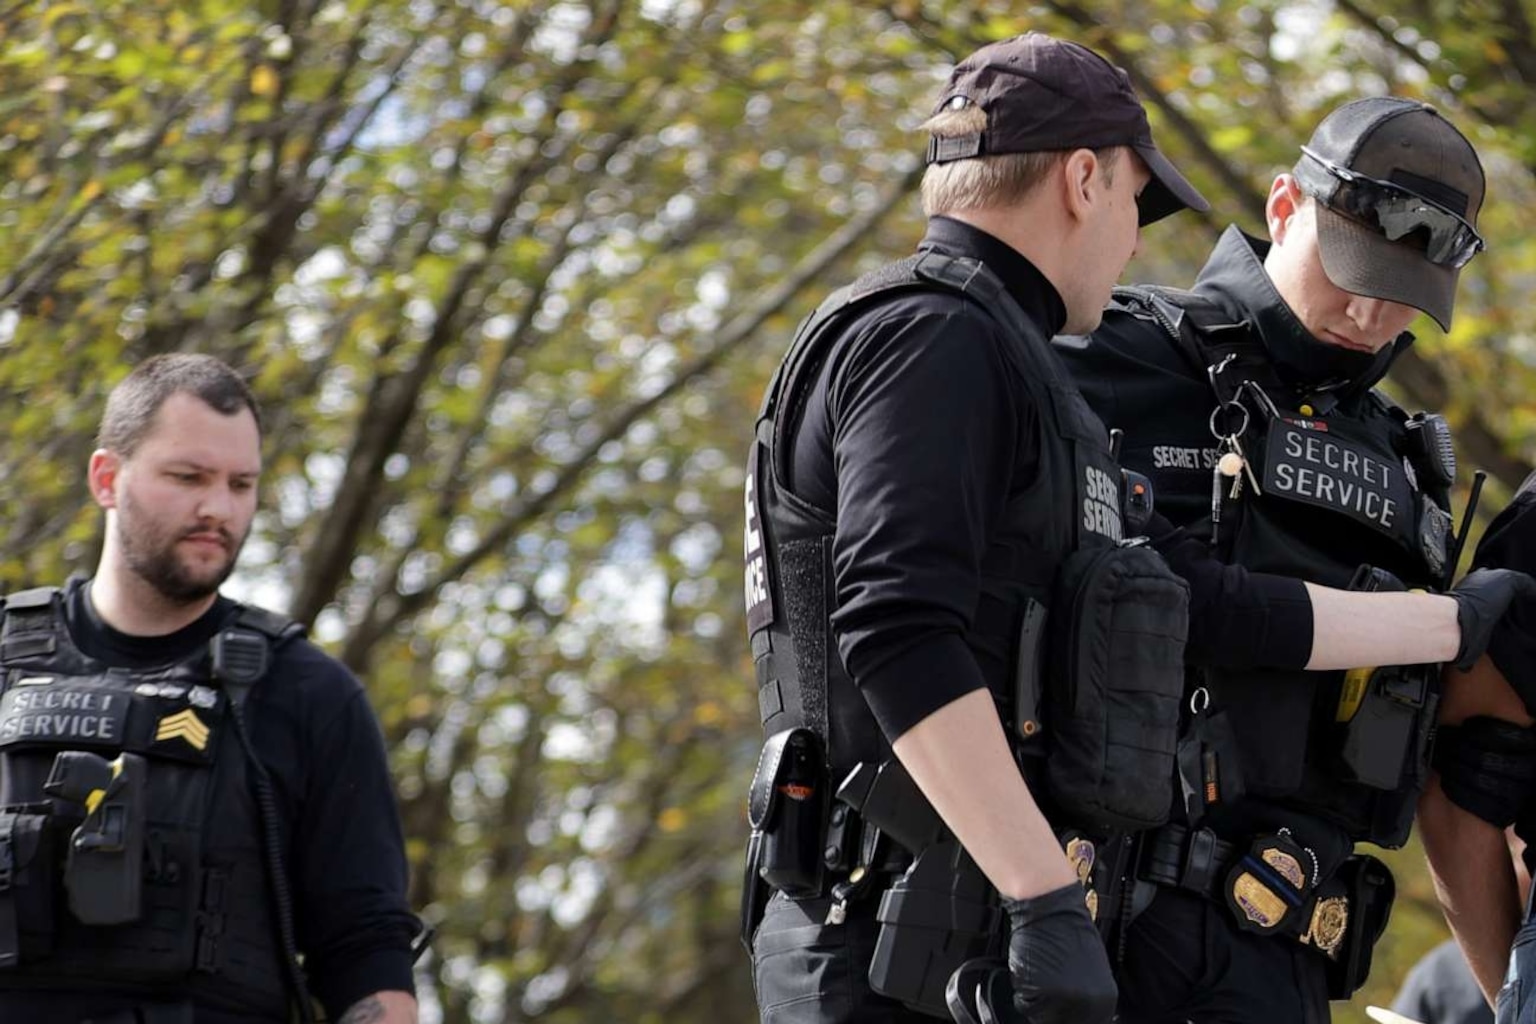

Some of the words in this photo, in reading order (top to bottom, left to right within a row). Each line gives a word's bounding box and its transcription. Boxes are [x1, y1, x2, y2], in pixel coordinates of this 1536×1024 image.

[1153, 445, 1201, 469] SECRET
[1285, 430, 1393, 490] SECRET
[1275, 463, 1397, 528] SERVICE
[13, 690, 113, 712] SECRET
[1, 714, 115, 738] SERVICE
